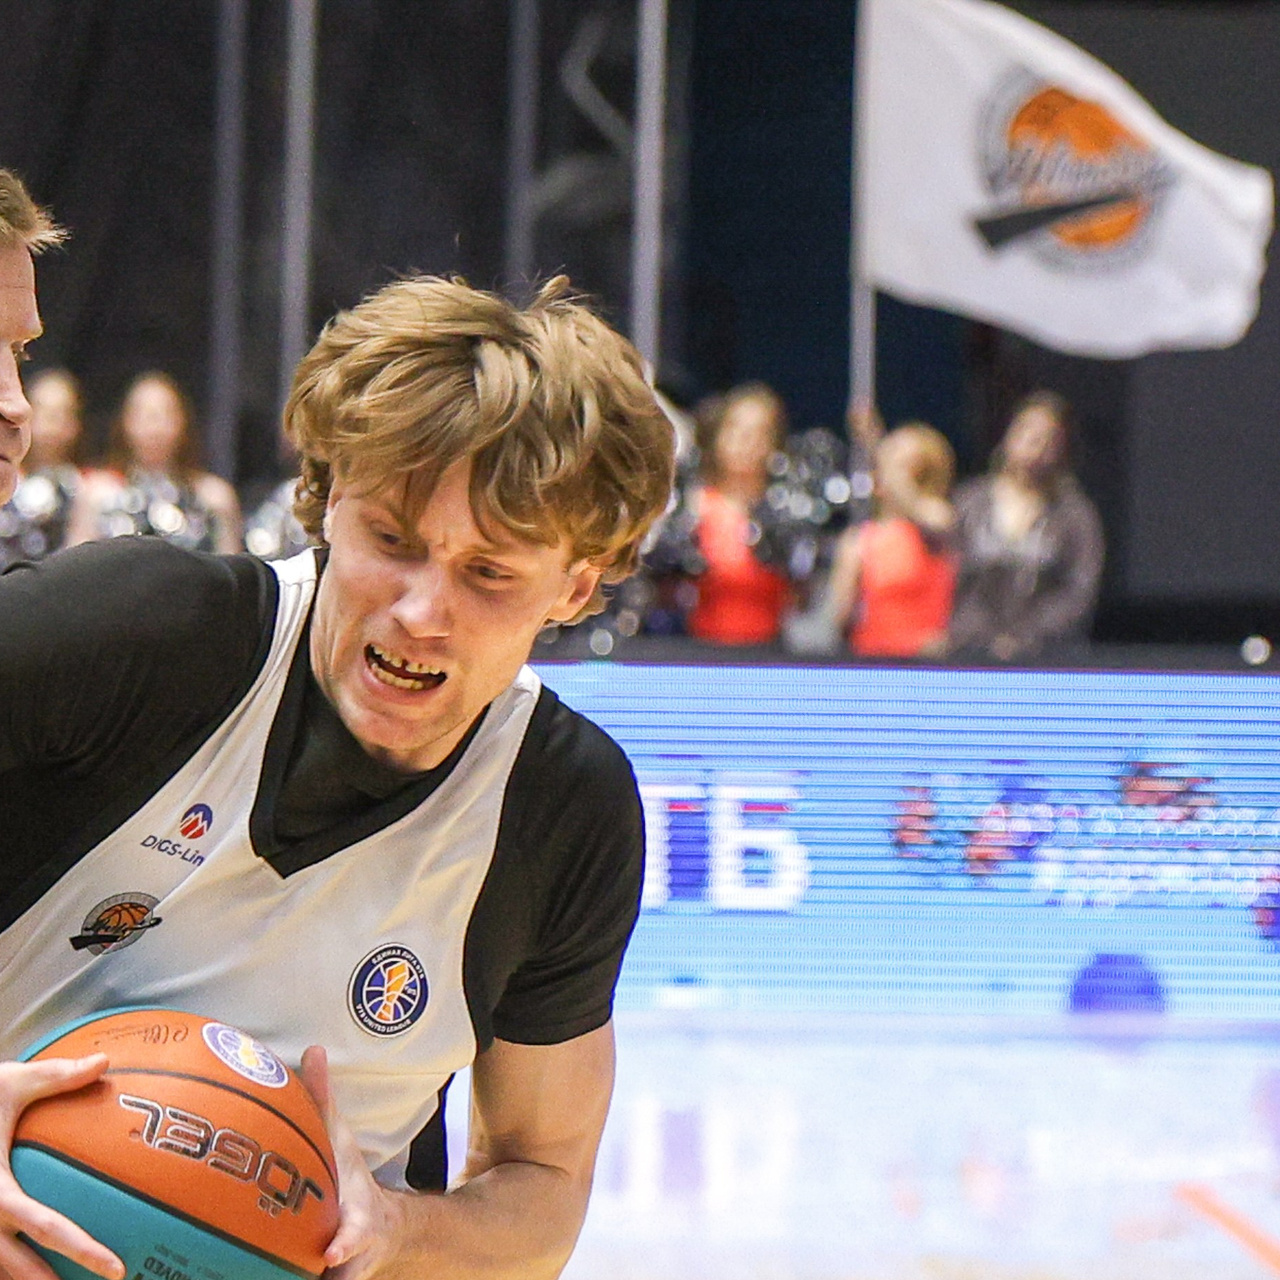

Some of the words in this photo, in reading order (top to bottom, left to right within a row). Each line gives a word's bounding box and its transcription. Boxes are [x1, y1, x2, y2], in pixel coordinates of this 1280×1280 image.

[140, 834, 206, 868] DIGS-Lin
[363, 1016, 386, 1032] UNITED
[119, 1093, 326, 1219] JÖGEL
